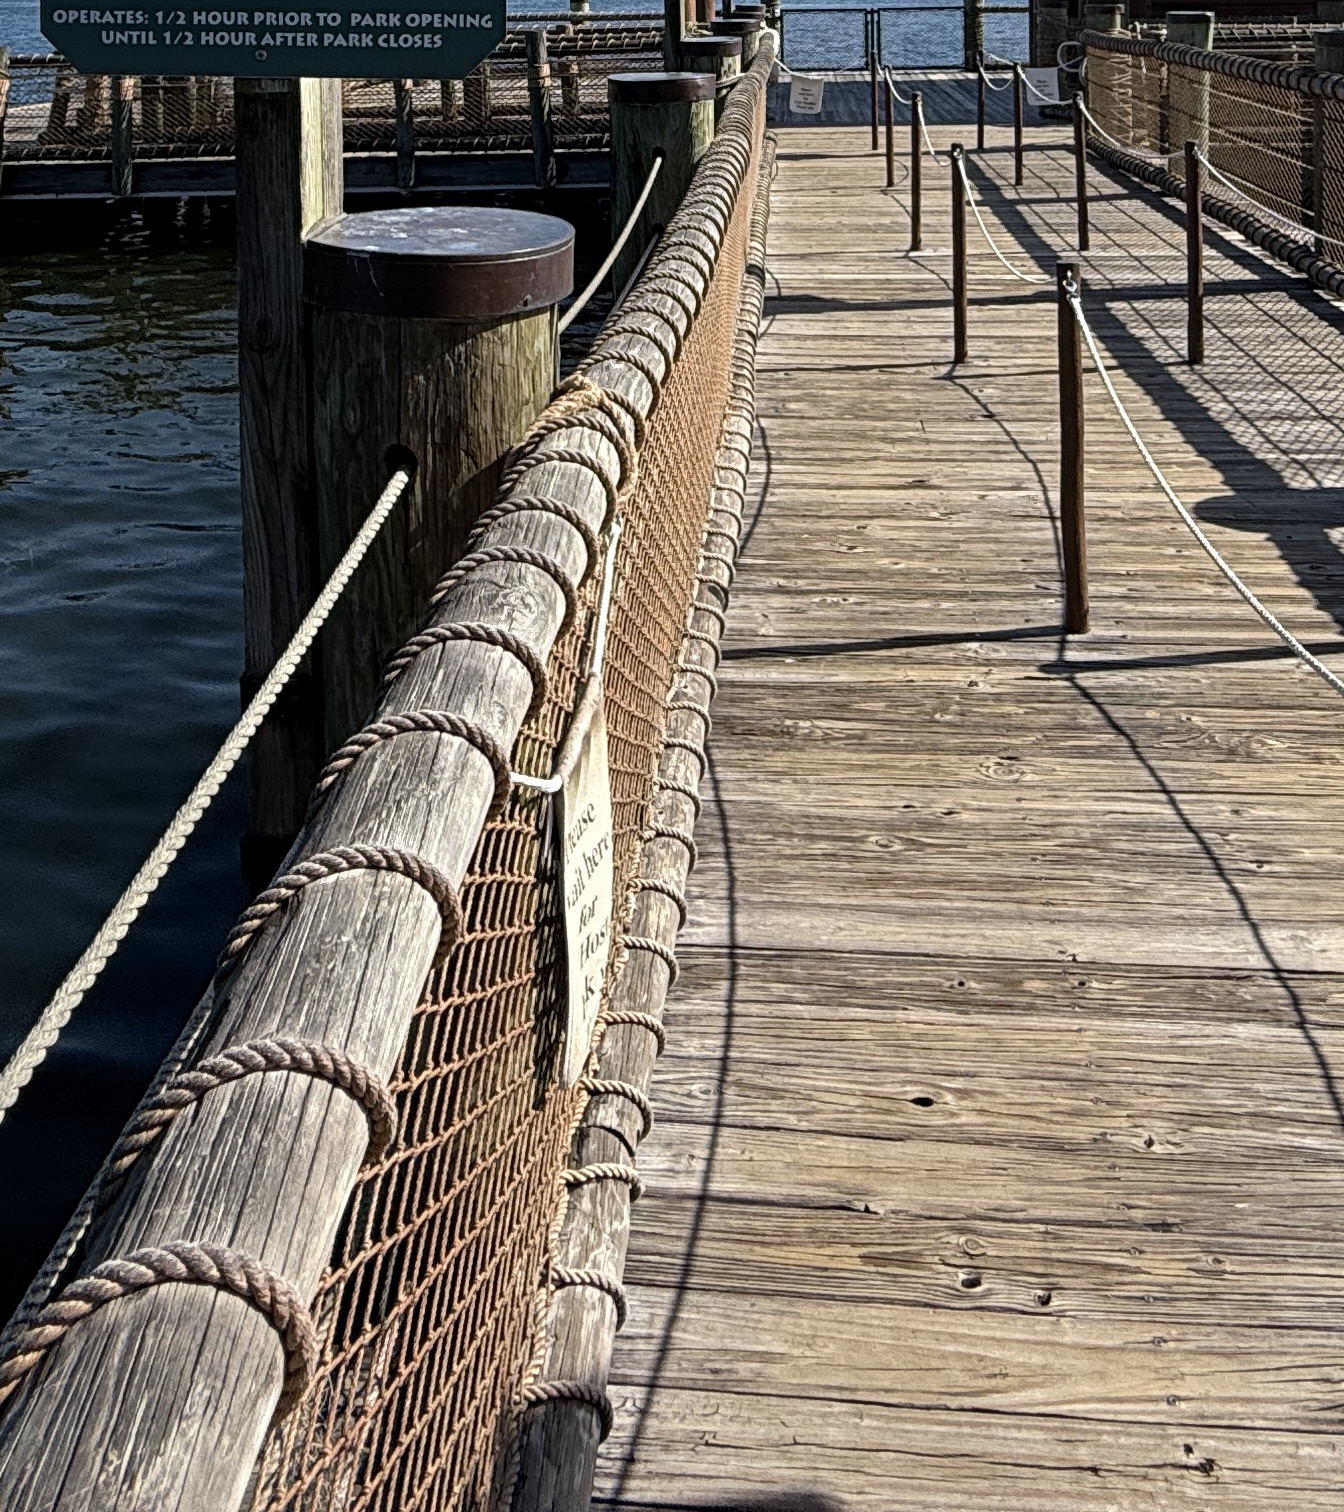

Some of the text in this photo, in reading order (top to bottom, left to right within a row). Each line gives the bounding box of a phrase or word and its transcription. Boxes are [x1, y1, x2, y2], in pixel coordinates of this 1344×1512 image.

[52, 9, 493, 28] OPERATES: 1/2 HOUR PRIOR TO PARK OPENING
[101, 30, 443, 48] UNTIL 1/2 HOUR AFTER PARK CLOSES
[582, 831, 609, 880] here
[578, 895, 598, 934] for
